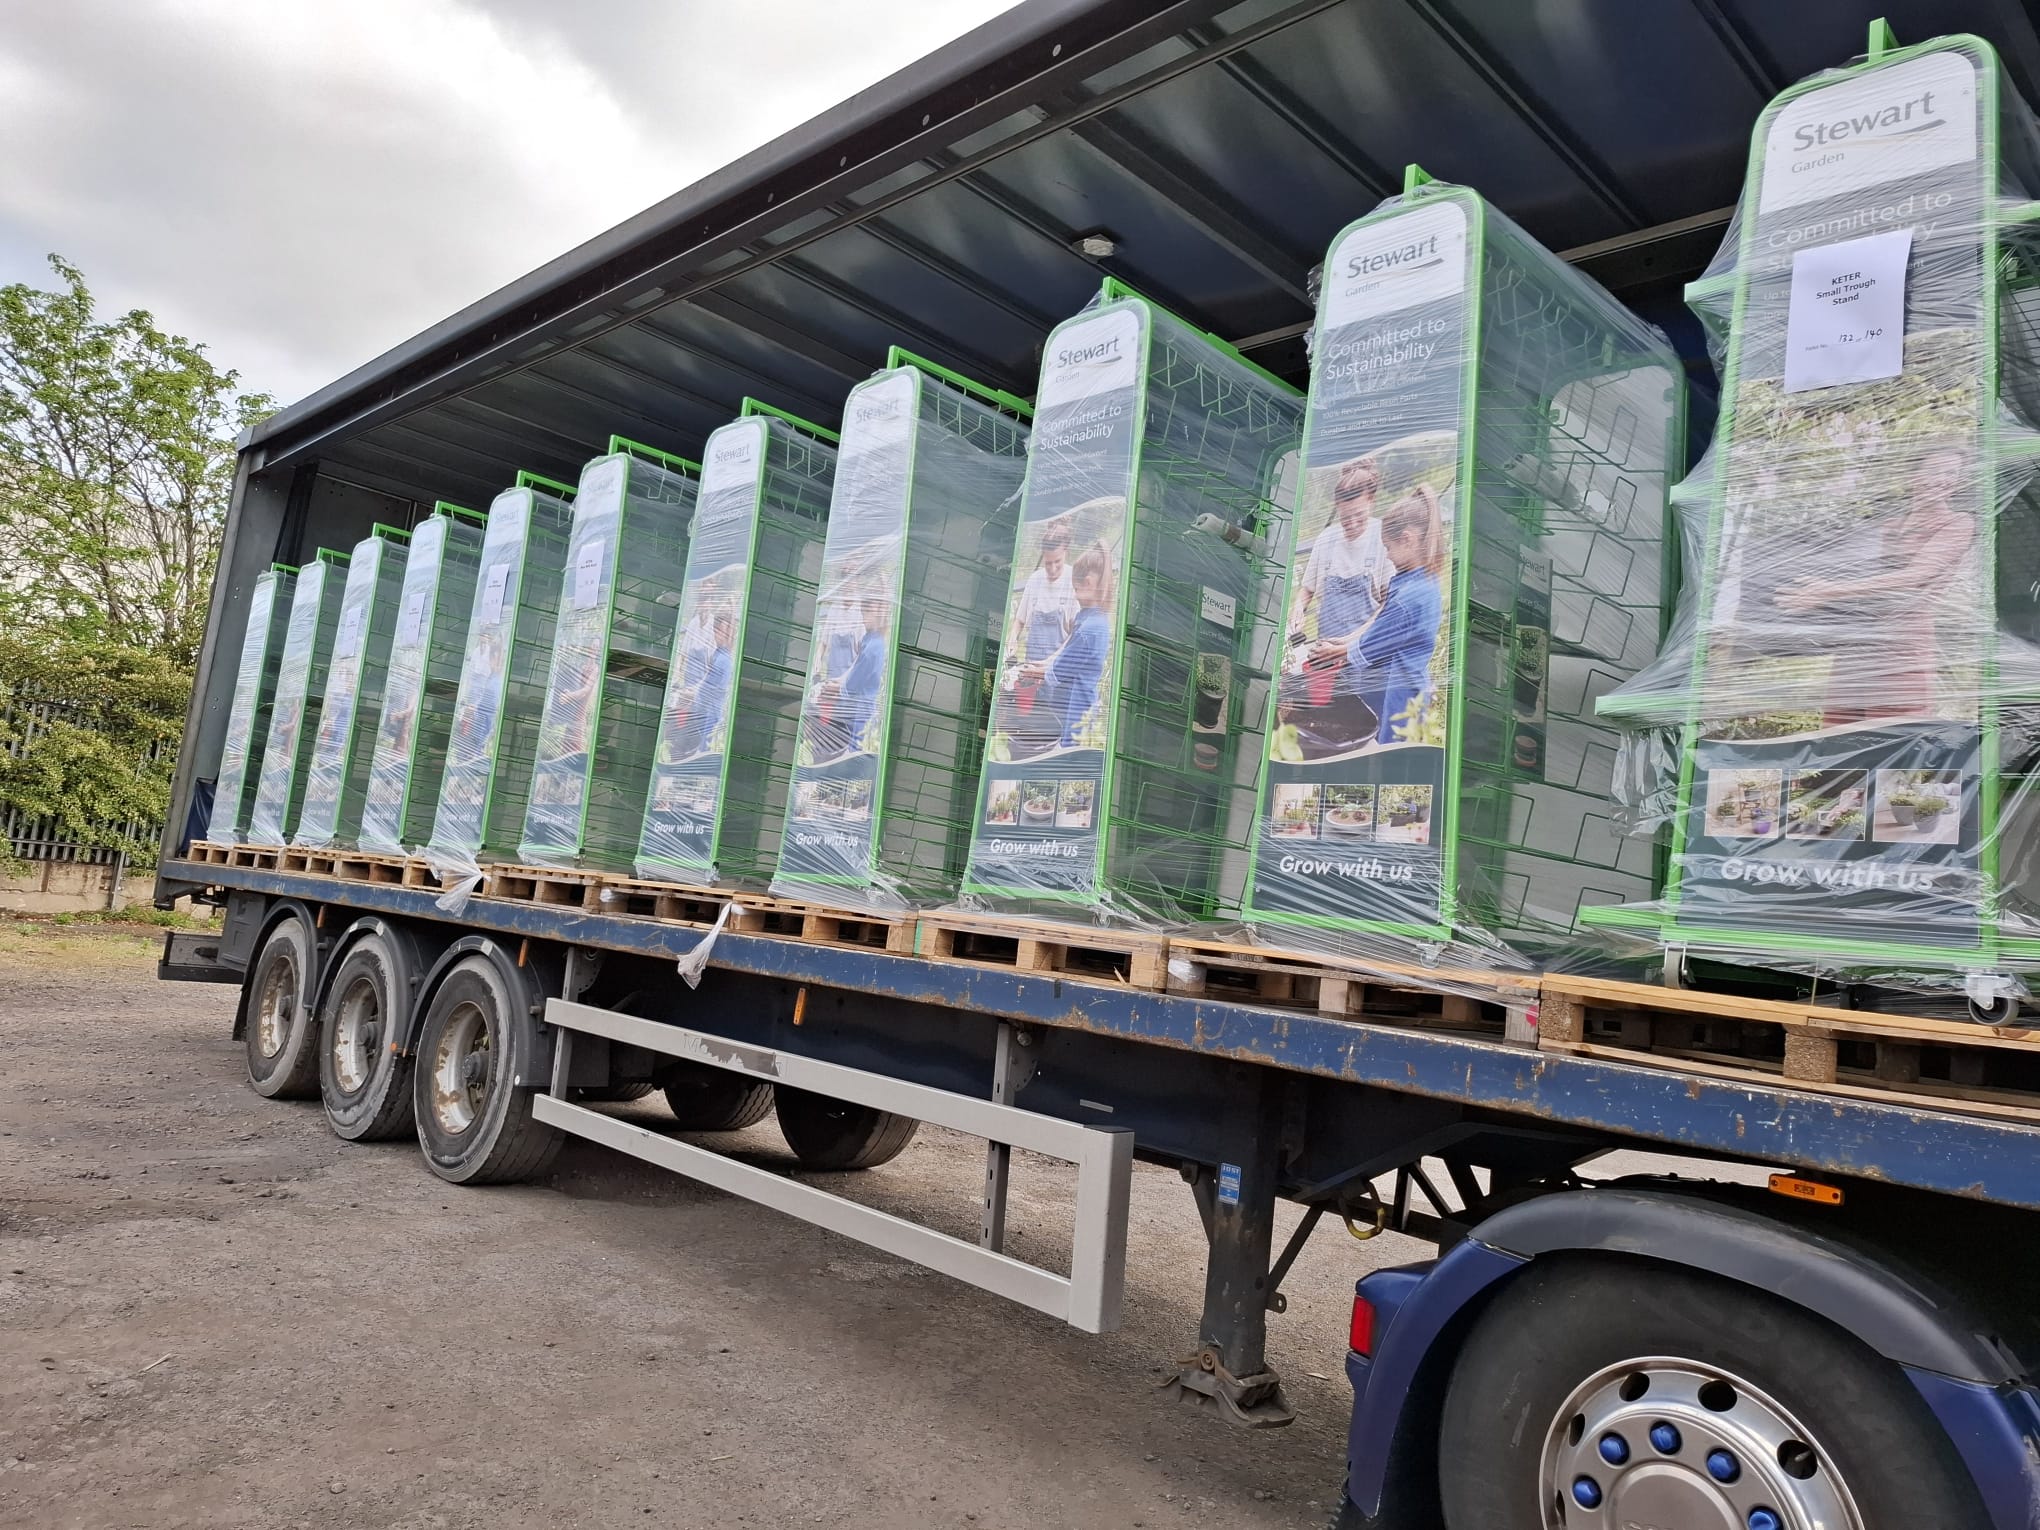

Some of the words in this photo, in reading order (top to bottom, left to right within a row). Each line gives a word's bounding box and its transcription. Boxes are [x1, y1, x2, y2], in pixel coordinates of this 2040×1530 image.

[1793, 91, 1936, 151] Stewart
[1791, 152, 1845, 174] Garden
[1768, 195, 1914, 247] Committed
[1925, 193, 1952, 211] to
[1347, 235, 1438, 279] Stewart
[1816, 287, 1841, 299] Small
[1844, 278, 1876, 293] Trough
[1831, 272, 1861, 286] KETER
[1832, 293, 1859, 306] Stand
[1057, 336, 1119, 368] Stewart
[1328, 320, 1422, 360] Committed
[1427, 319, 1446, 334] to
[1326, 341, 1435, 380] Sustainability
[1042, 405, 1106, 433] Committed
[1109, 406, 1122, 417] to
[1040, 423, 1114, 450] Sustainability
[1202, 592, 1231, 612] Stewart
[654, 821, 676, 833] Grow
[676, 821, 694, 834] with
[696, 825, 705, 835] us
[795, 832, 822, 846] Grow
[824, 832, 845, 847] with
[846, 837, 859, 847] us
[990, 838, 1026, 854] Grow
[1029, 839, 1059, 856] with
[1062, 845, 1079, 857] us
[1279, 855, 1331, 876] Grow
[1338, 857, 1382, 878] with
[1390, 864, 1413, 881] us
[1721, 858, 1804, 883] Grow
[1813, 861, 1885, 888] with
[1897, 869, 1933, 890] us
